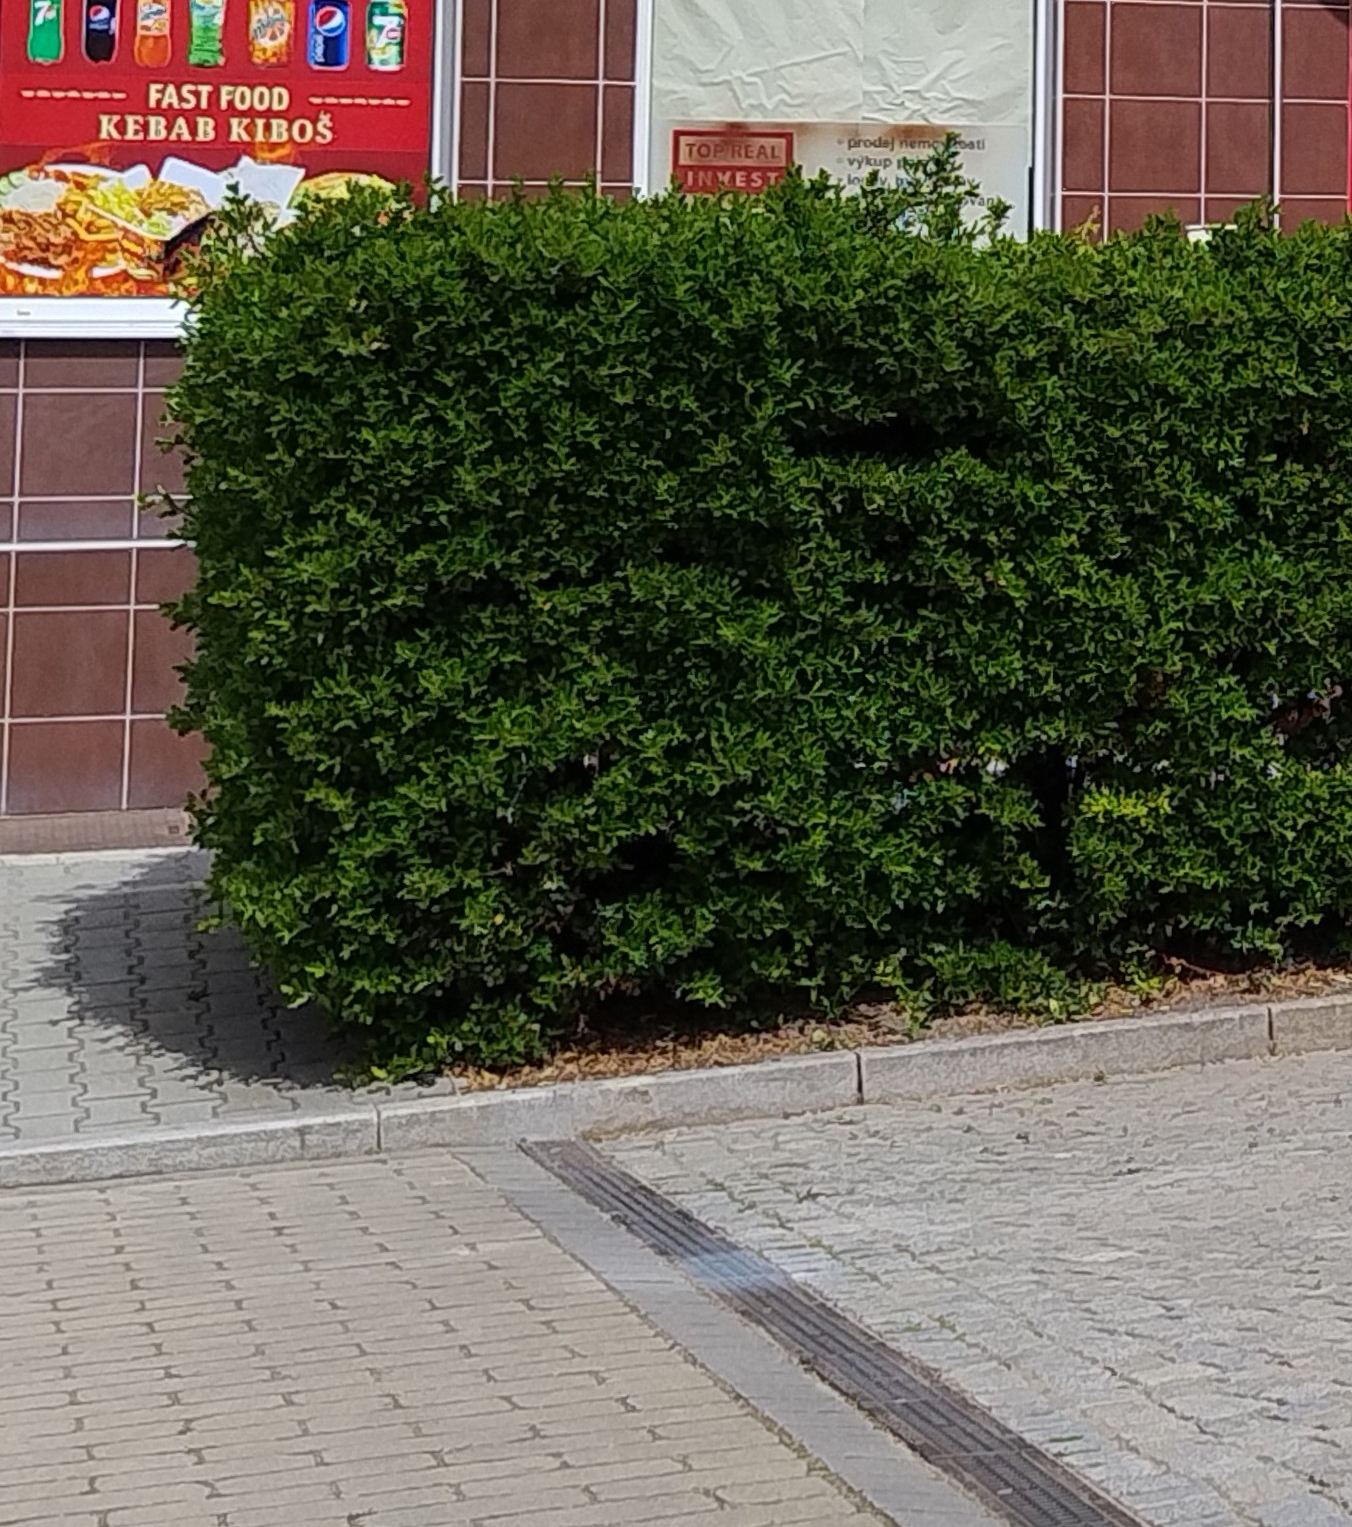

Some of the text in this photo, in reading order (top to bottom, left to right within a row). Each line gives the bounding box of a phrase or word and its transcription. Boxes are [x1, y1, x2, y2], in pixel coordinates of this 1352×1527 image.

[148, 82, 290, 112] FAST FOOD
[99, 112, 333, 145] KEBAB KIBOŠ
[685, 142, 780, 160] TOP REAL
[847, 138, 895, 152] prodej
[847, 155, 892, 170] výkup
[687, 171, 779, 189] INVEST
